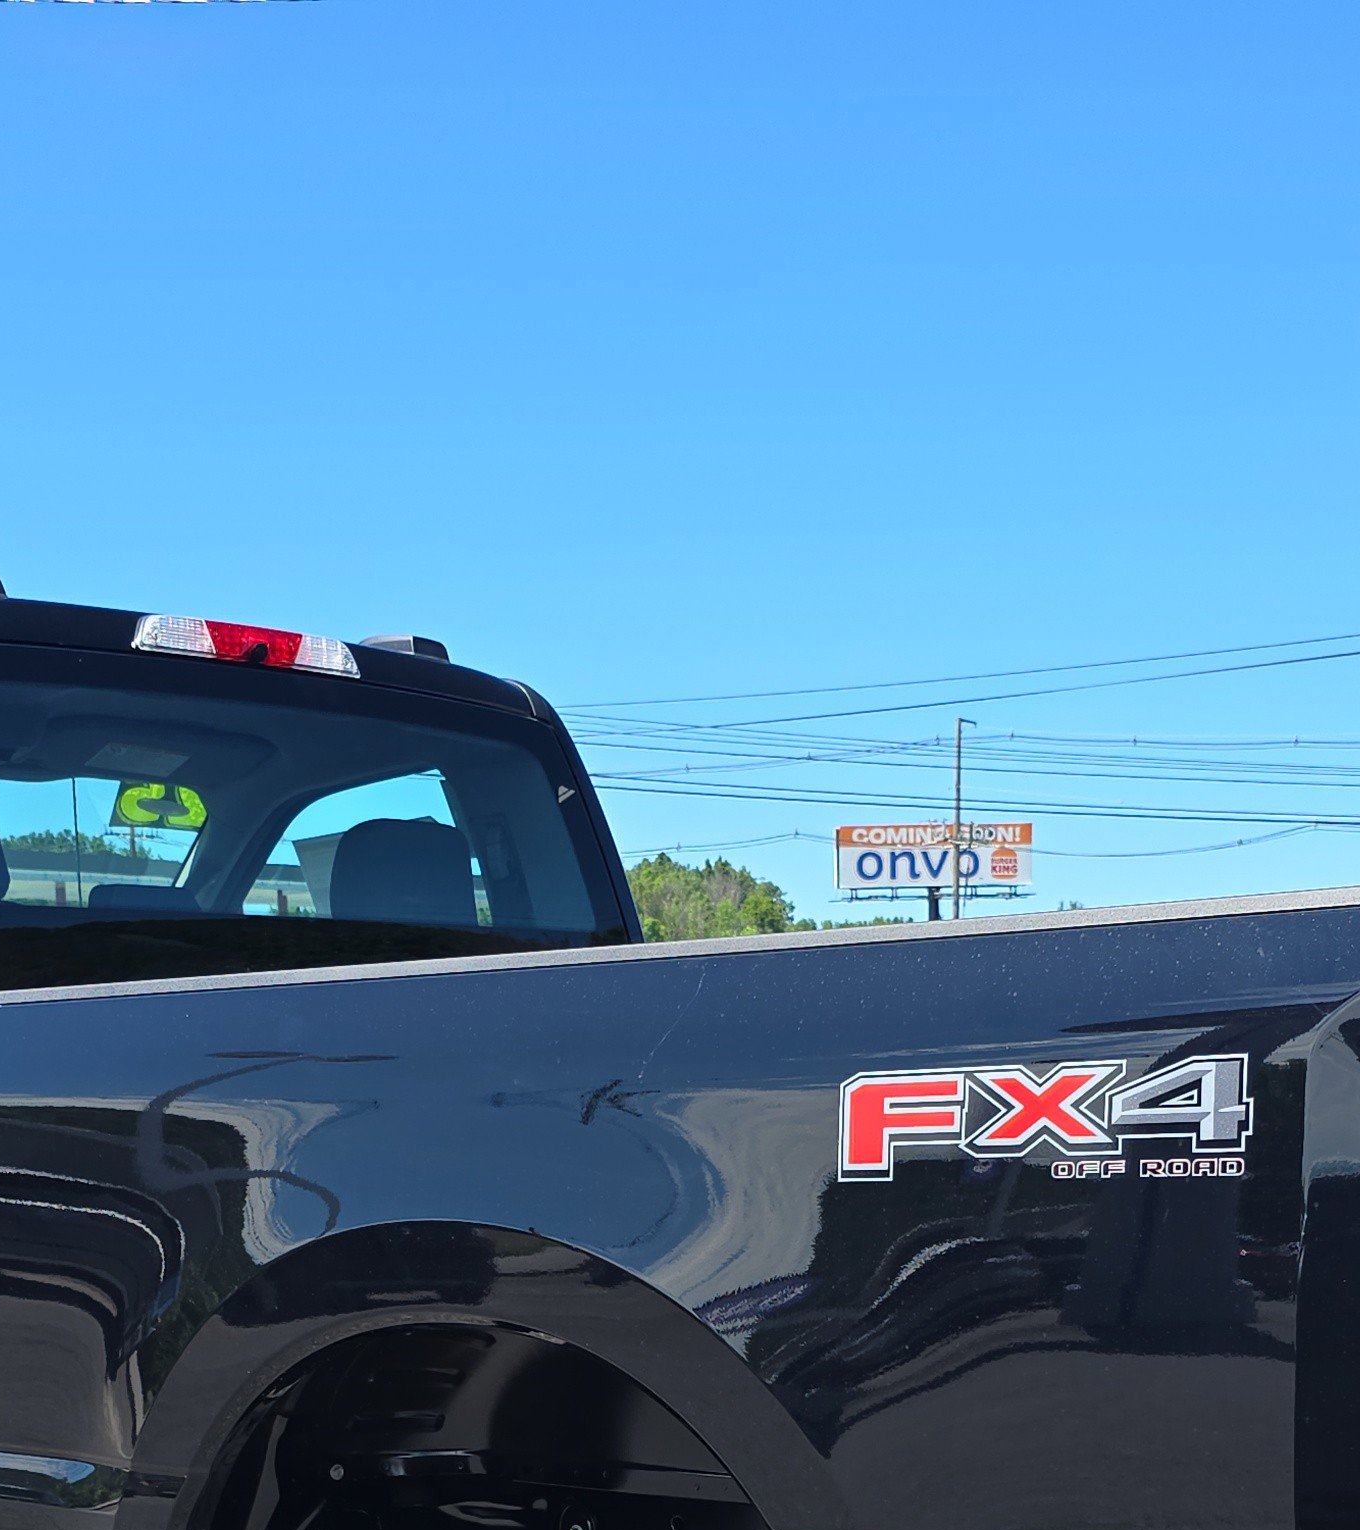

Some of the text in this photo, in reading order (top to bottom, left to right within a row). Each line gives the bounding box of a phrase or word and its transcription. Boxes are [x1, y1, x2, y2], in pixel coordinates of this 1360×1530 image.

[990, 865, 1019, 874] KING
[838, 1053, 1254, 1182] FX4
[1050, 1156, 1246, 1180] OFF ROAD
